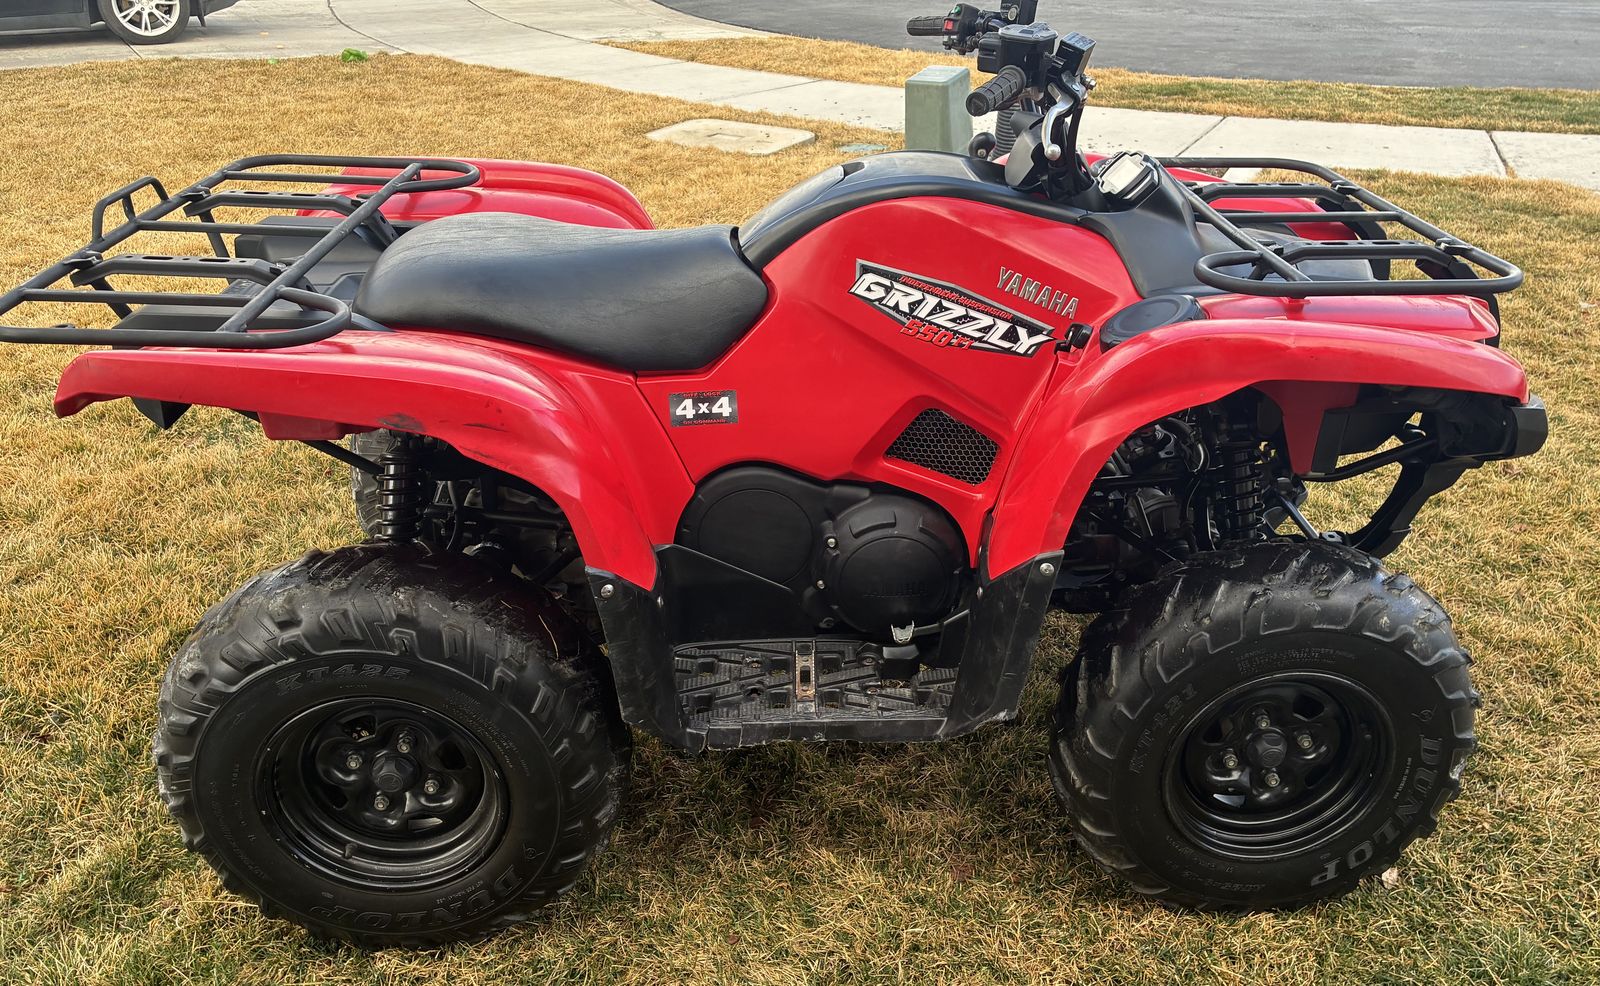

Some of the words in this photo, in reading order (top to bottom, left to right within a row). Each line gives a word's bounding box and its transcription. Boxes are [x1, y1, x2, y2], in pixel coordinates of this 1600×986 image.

[849, 271, 1056, 354] GRIZZLY
[996, 265, 1079, 319] YAMAHA
[900, 319, 954, 347] 550
[675, 396, 732, 419] 4x4
[863, 581, 929, 598] AMAHA
[1310, 733, 1443, 887] DUNLOP
[308, 864, 523, 929] DUNLOP
